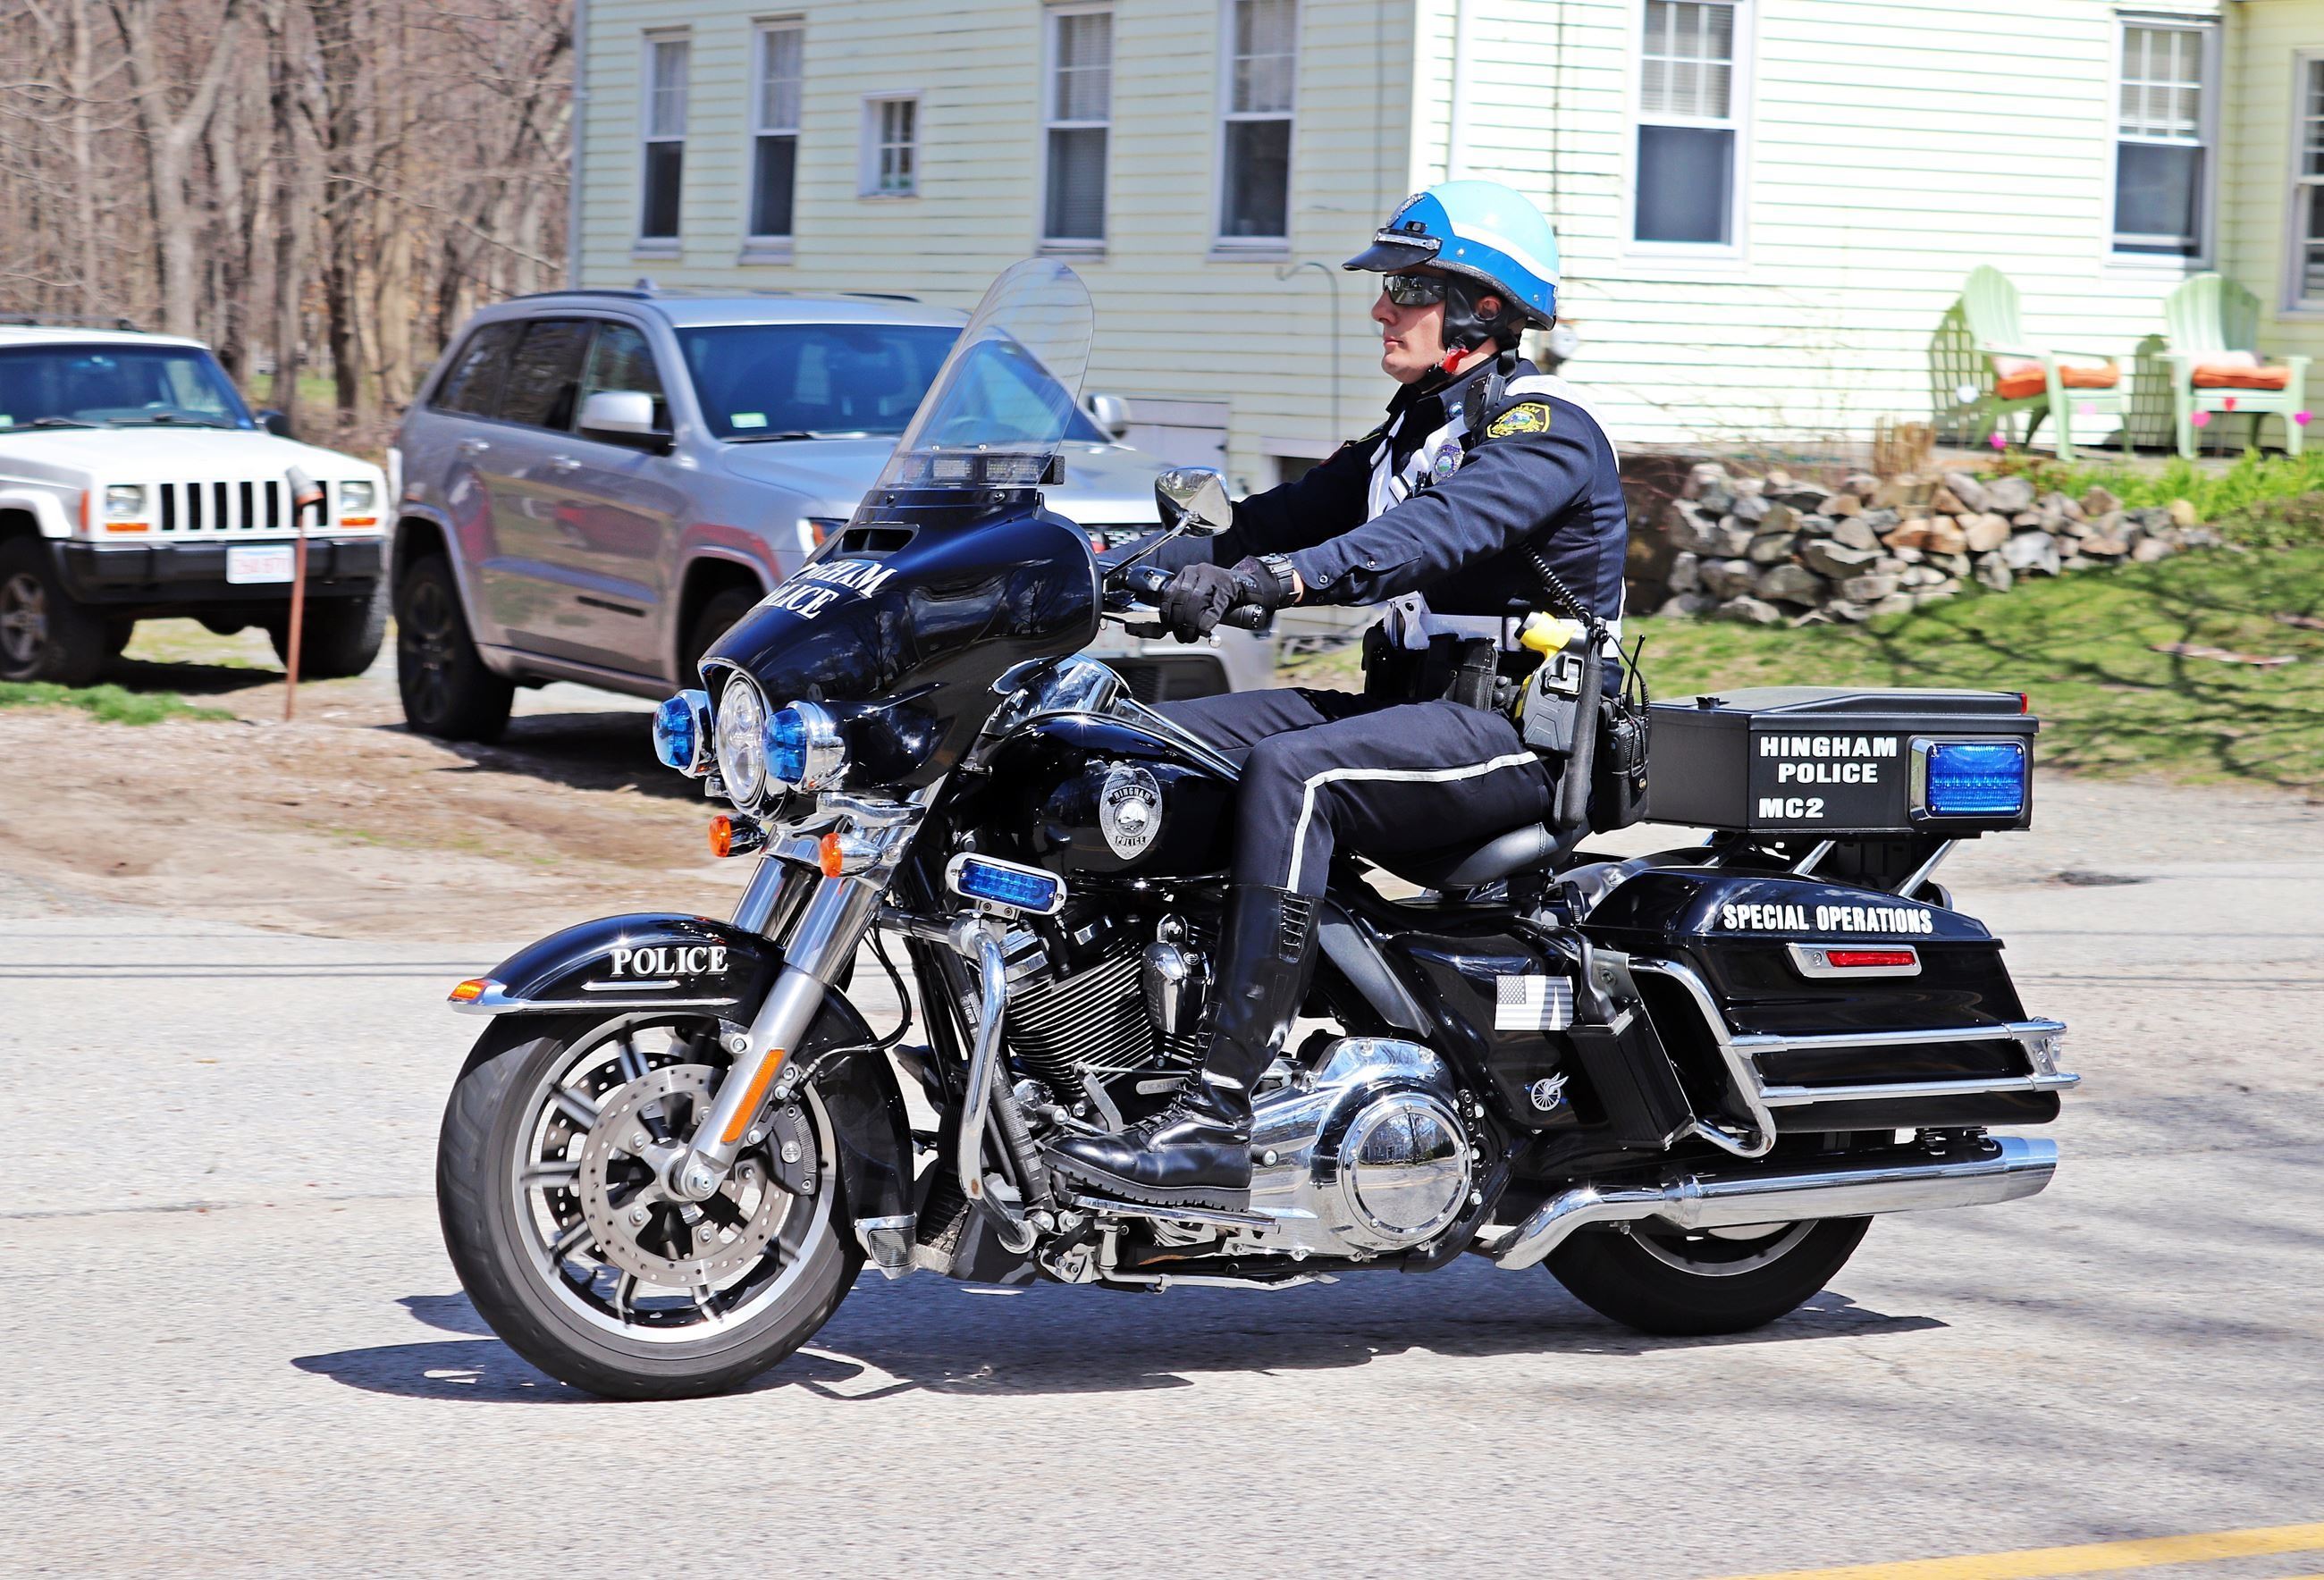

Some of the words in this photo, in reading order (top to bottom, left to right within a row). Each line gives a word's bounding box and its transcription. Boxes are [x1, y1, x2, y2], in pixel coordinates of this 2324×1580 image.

[1759, 736, 1898, 757] HINGHAM
[1777, 763, 1878, 784] POLICE
[1113, 787, 1151, 801] HINGHAM
[1758, 798, 1824, 819] MC2
[1116, 836, 1146, 846] POLICE
[1722, 904, 1810, 930] SPECIAL
[1815, 905, 1933, 934] OPERATIONS
[610, 945, 728, 978] POLICE
